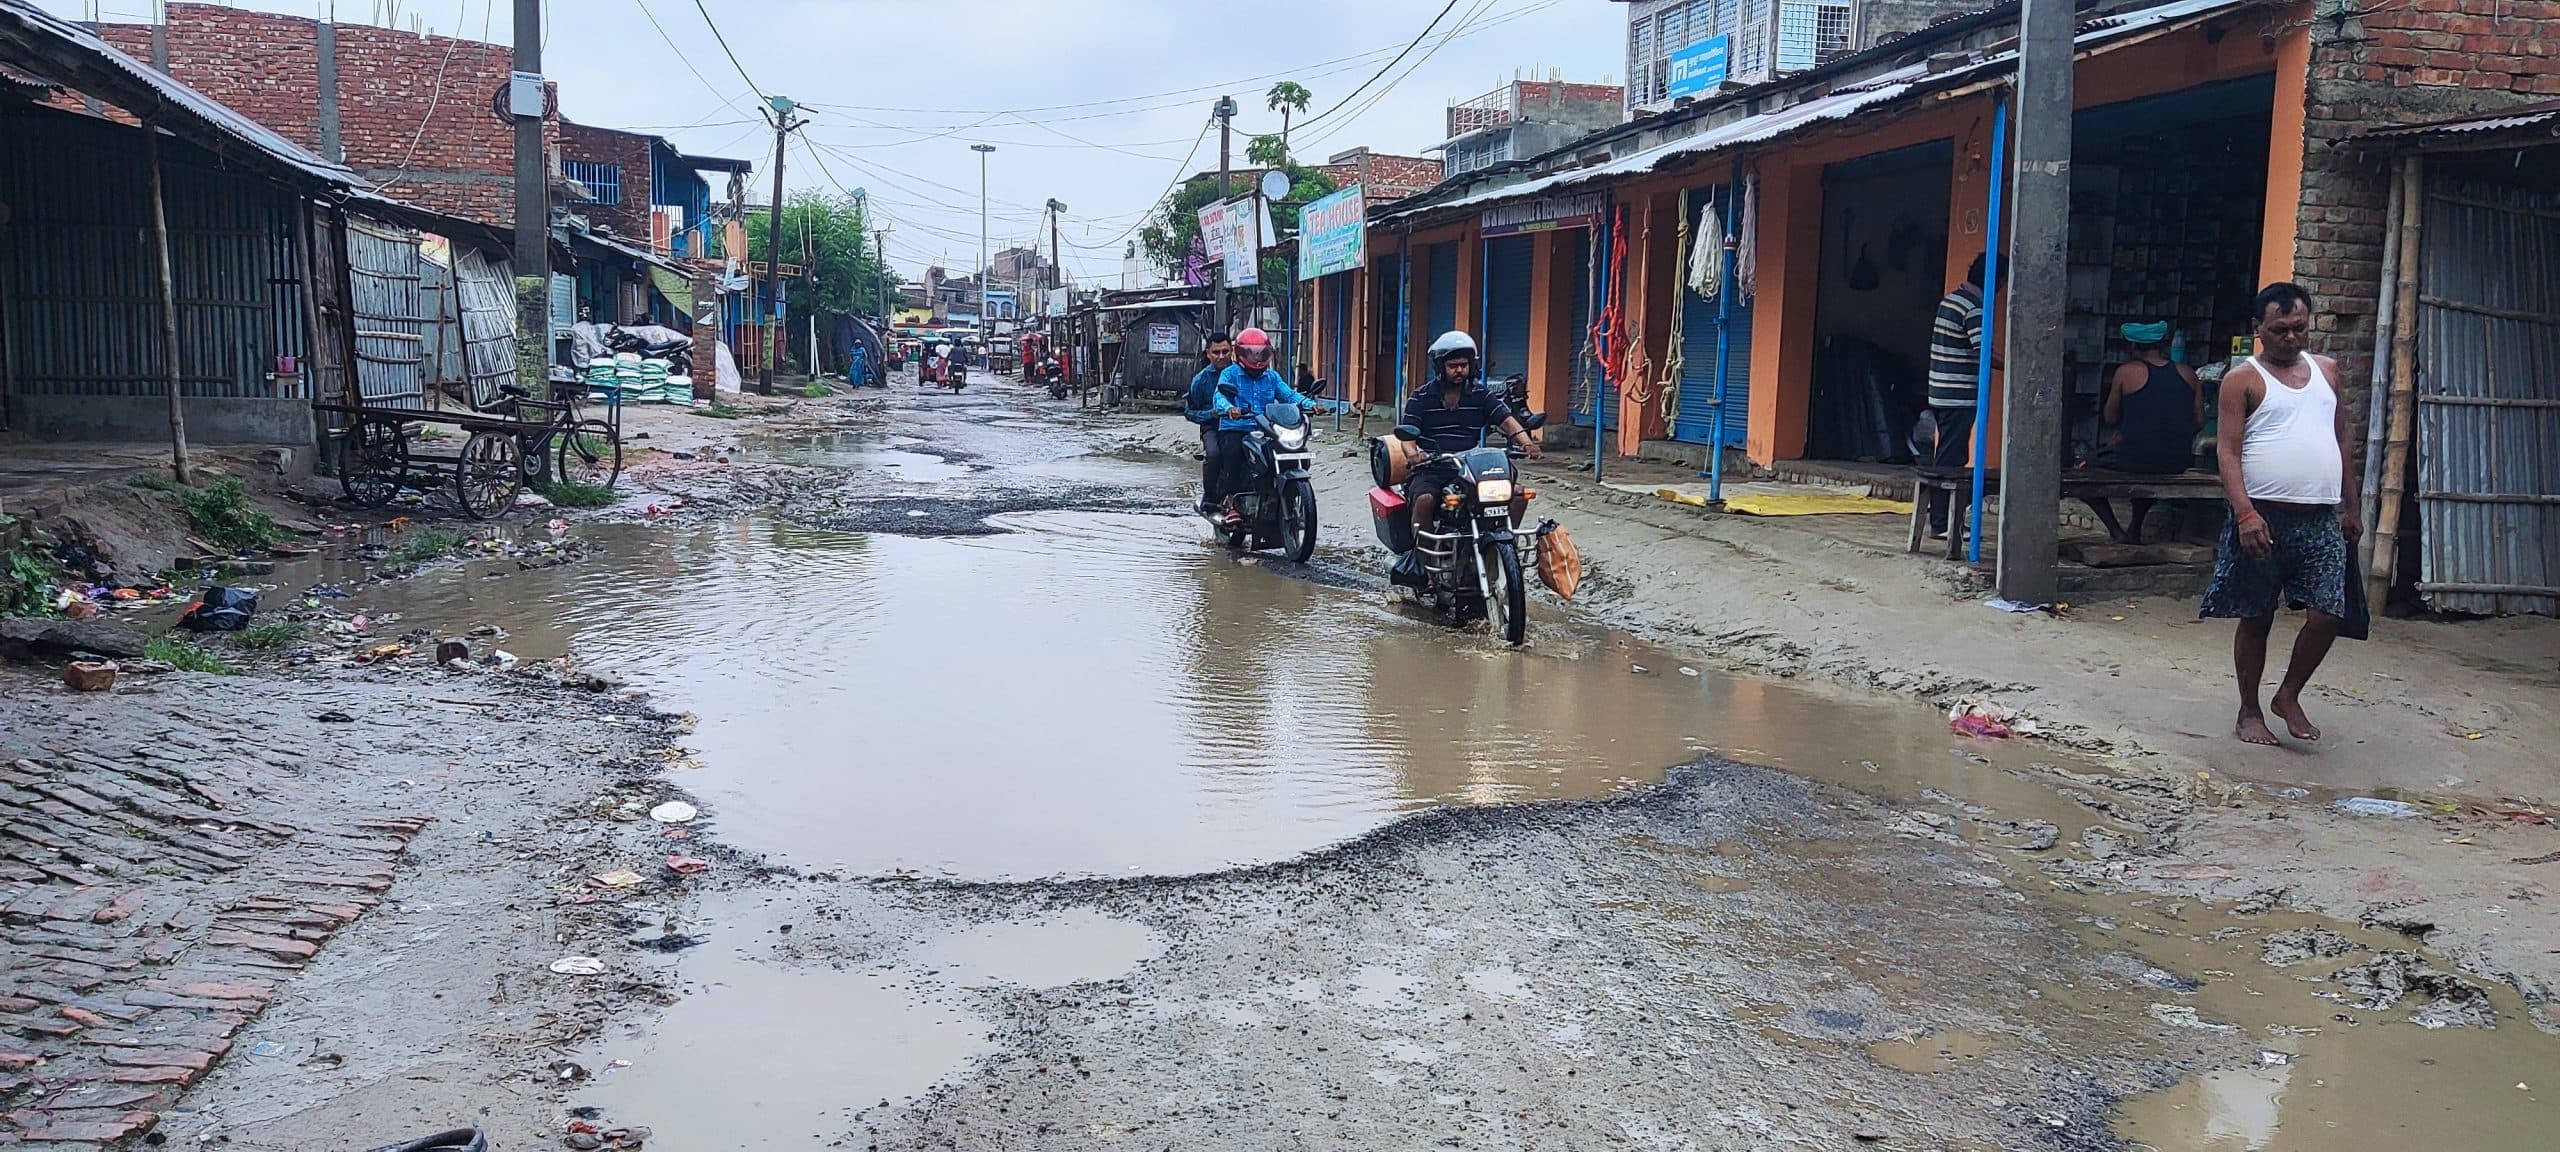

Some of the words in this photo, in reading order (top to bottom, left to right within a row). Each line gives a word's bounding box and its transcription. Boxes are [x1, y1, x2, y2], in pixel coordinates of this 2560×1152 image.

[1308, 212, 1327, 236] TEA
[1328, 198, 1360, 231] HOUSE
[1536, 204, 1542, 219] &
